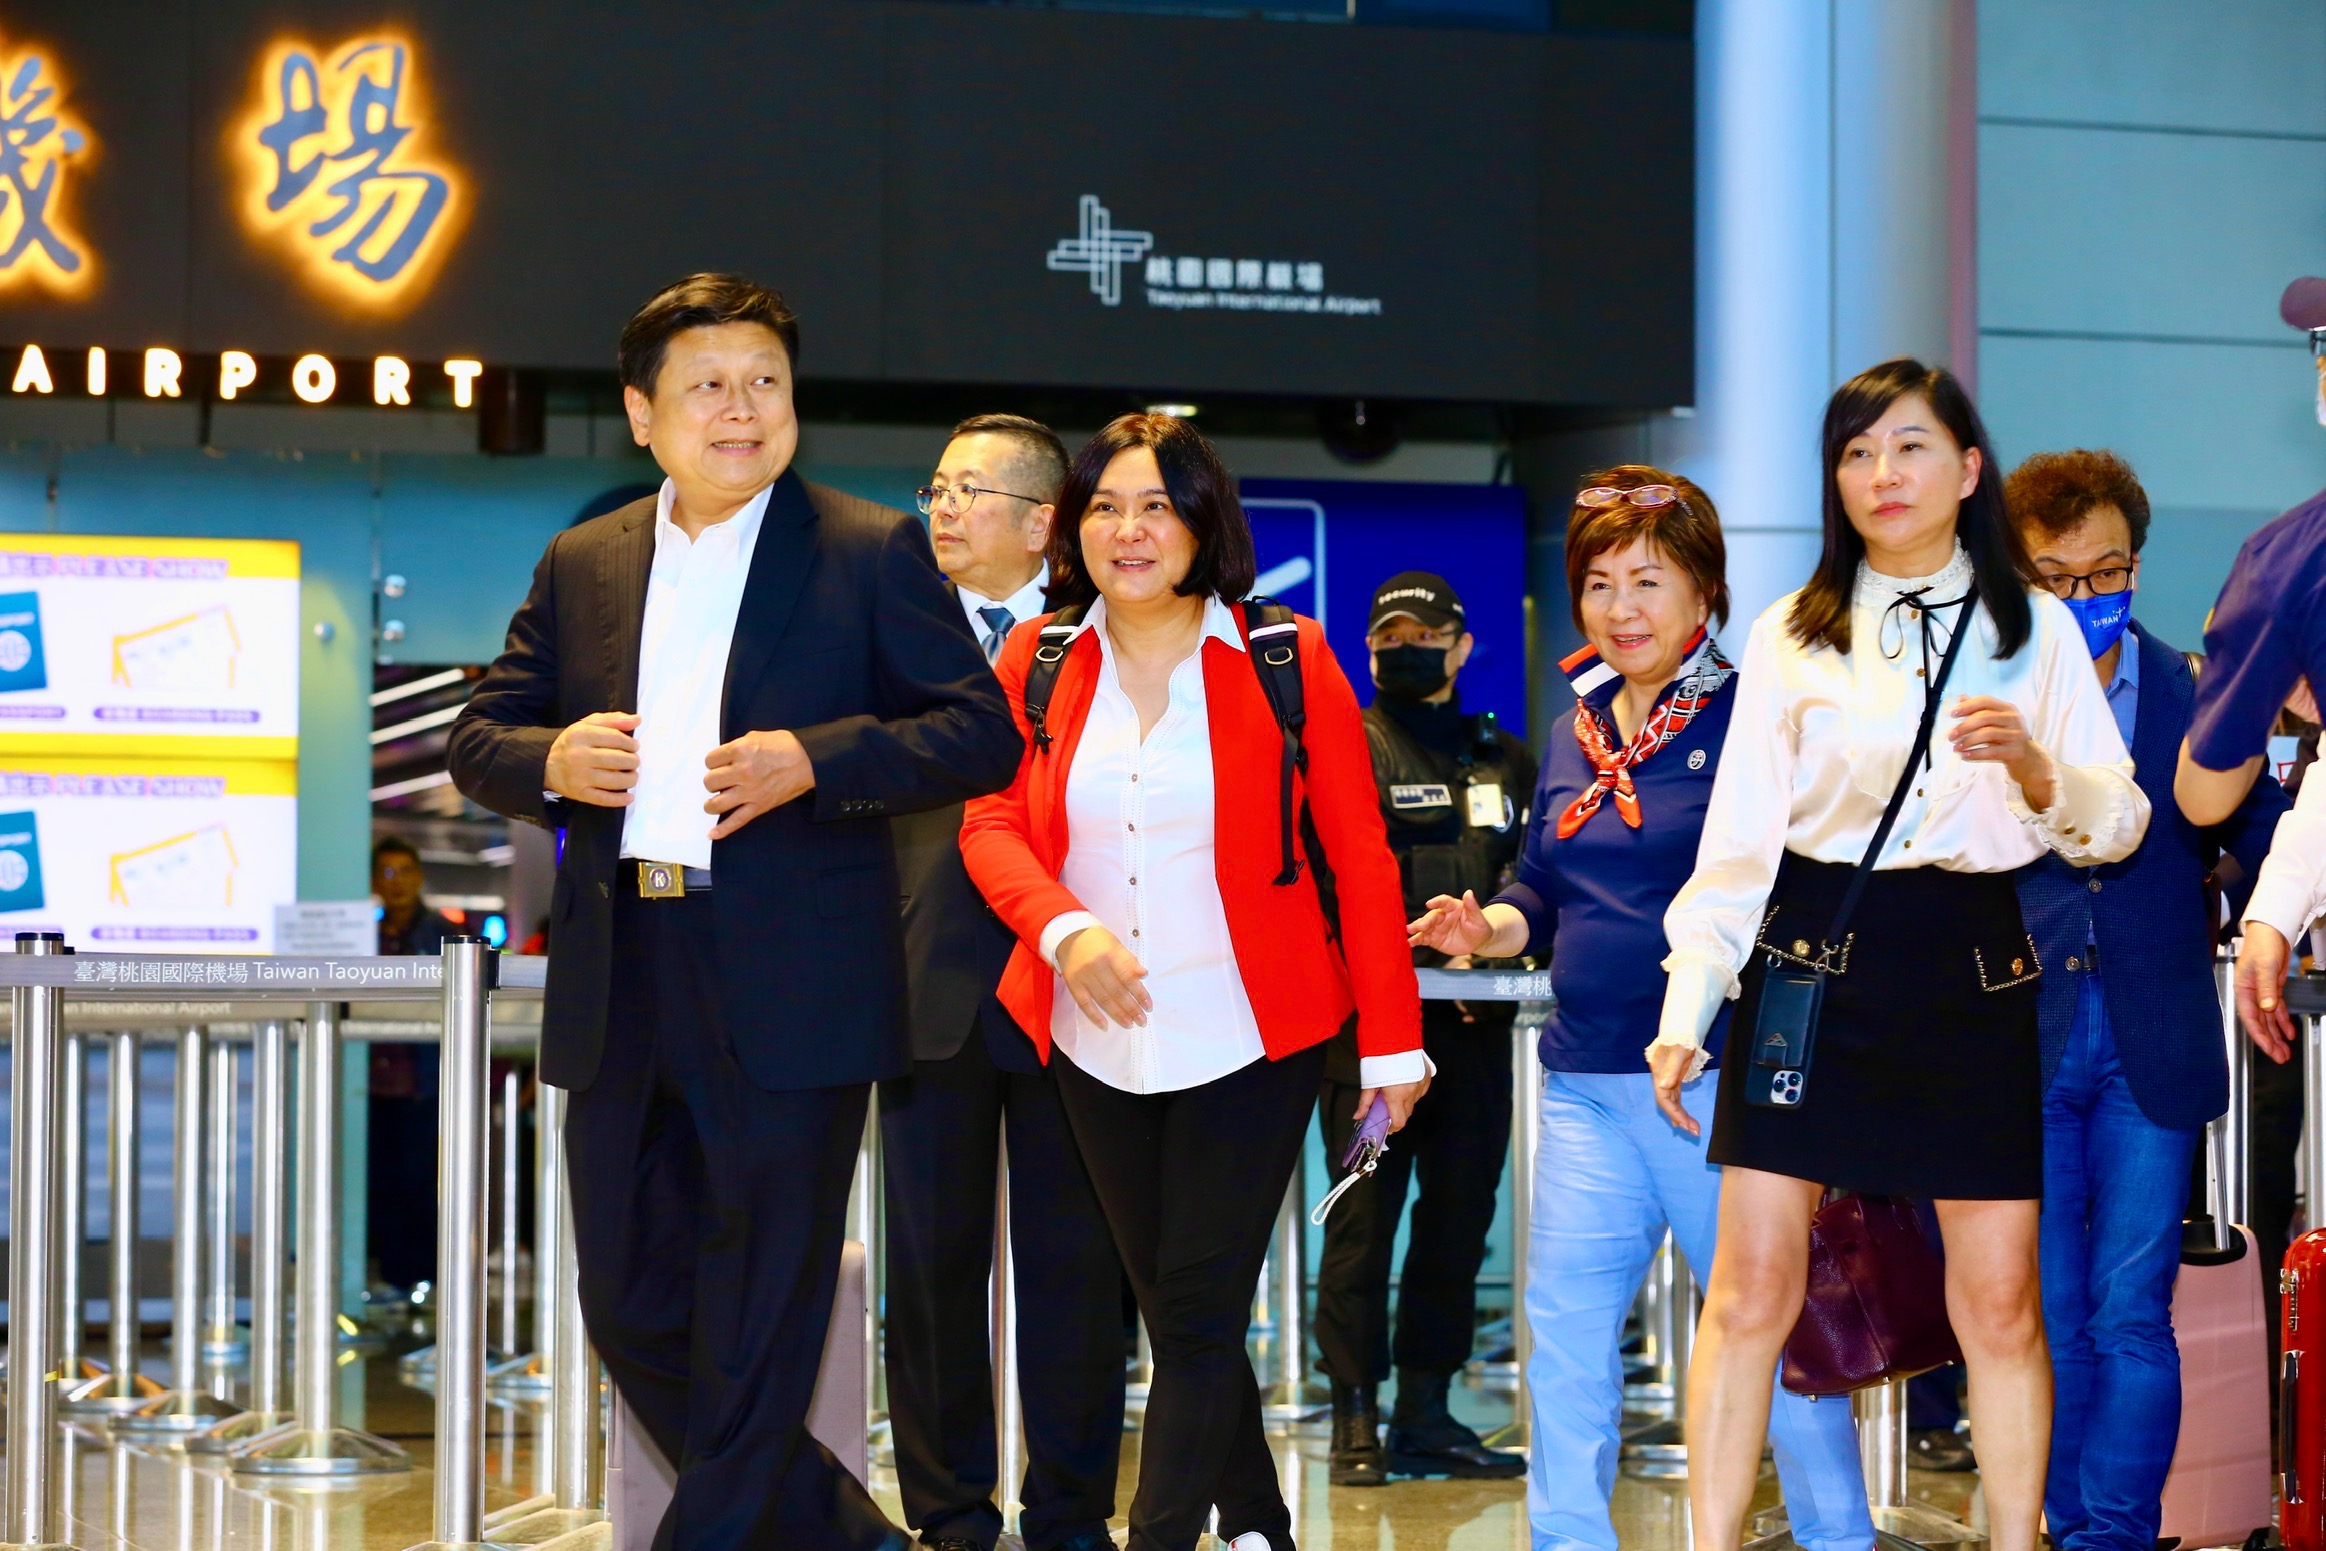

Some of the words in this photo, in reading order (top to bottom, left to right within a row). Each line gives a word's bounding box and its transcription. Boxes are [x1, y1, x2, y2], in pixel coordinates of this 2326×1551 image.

[1216, 292, 1321, 312] International
[1323, 295, 1382, 316] Airport
[11, 344, 483, 408] AIRPORT
[1378, 587, 1435, 606] security
[2091, 614, 2119, 628] TAWAN
[74, 961, 248, 984] 臺灣桃園國際機場
[253, 962, 319, 980] Taiwan
[325, 962, 406, 985] Taoyuan
[1493, 974, 1555, 998] 臺灣桃
[177, 1001, 231, 1017] Airport
